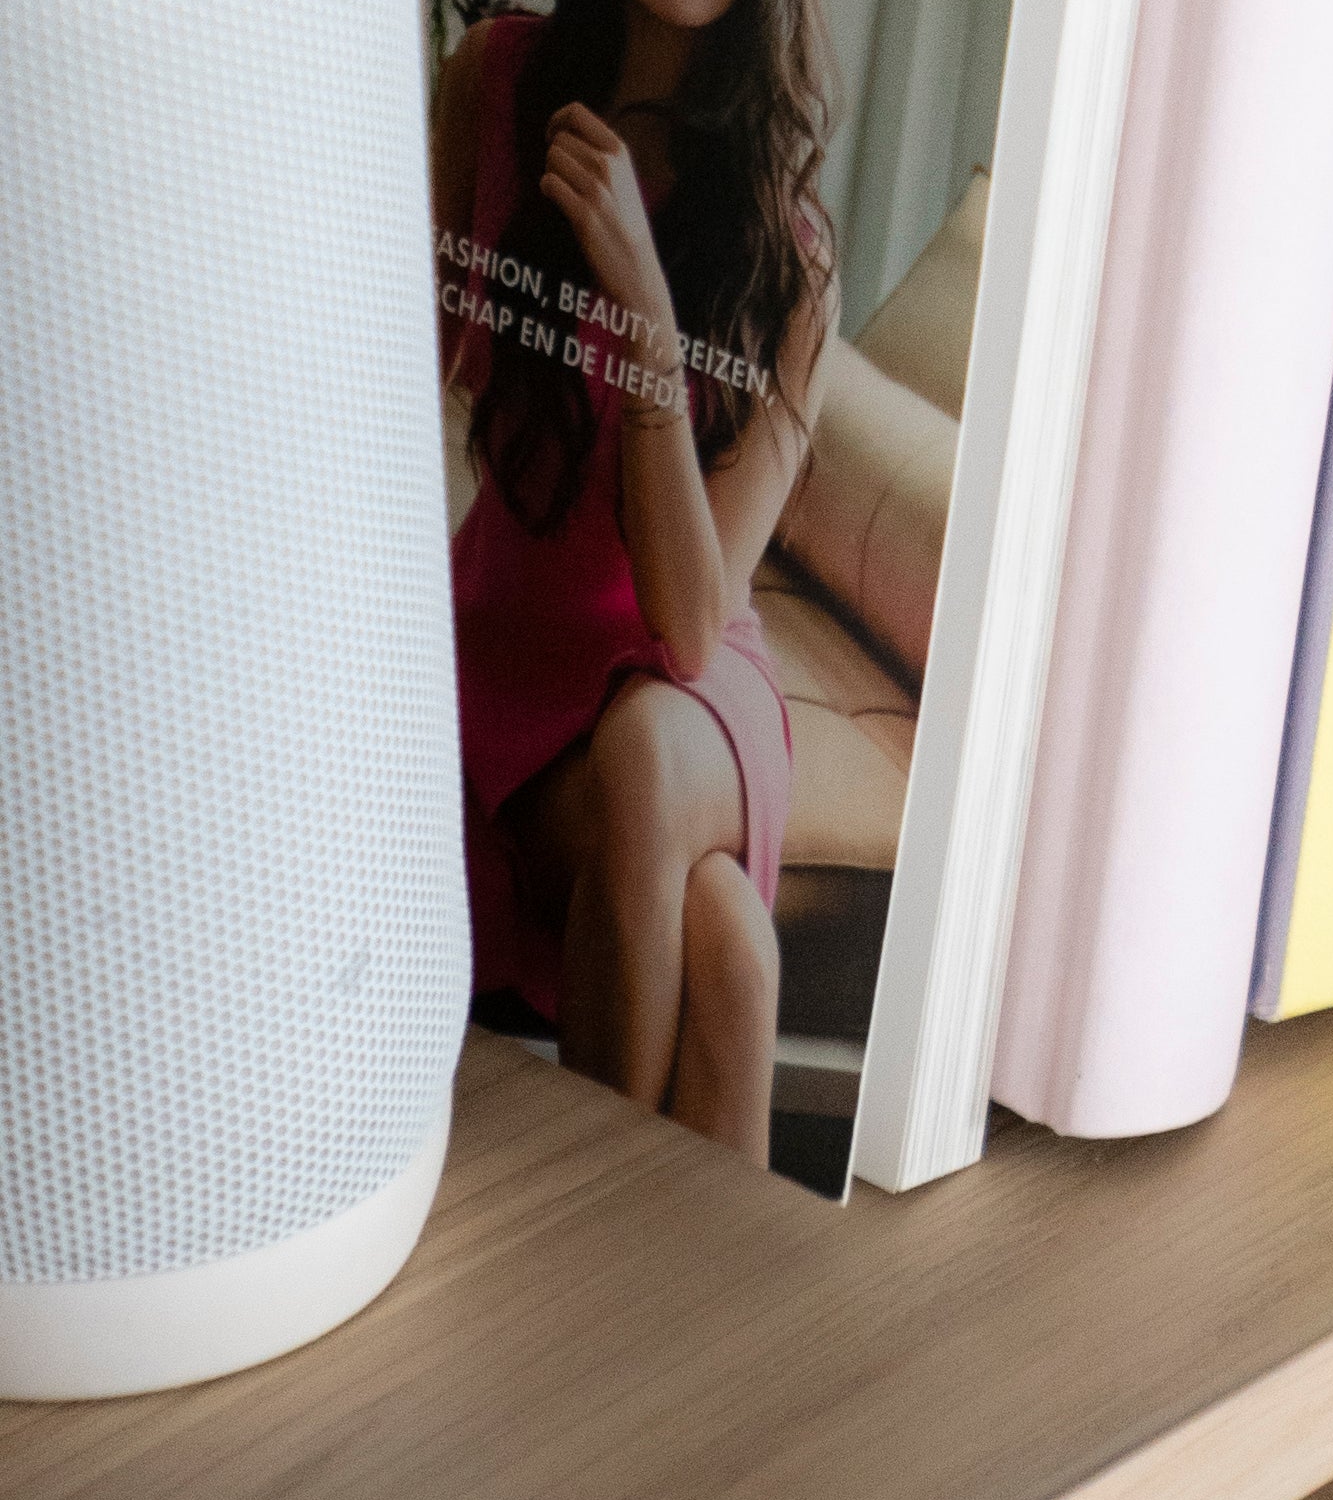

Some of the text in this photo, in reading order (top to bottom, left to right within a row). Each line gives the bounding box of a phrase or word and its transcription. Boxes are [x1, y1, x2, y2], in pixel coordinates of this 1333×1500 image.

[436, 276, 690, 412] CHAP EN DE LIEFDE
[557, 279, 663, 360] BEAUTY,
[673, 329, 776, 407] REIZEN,
